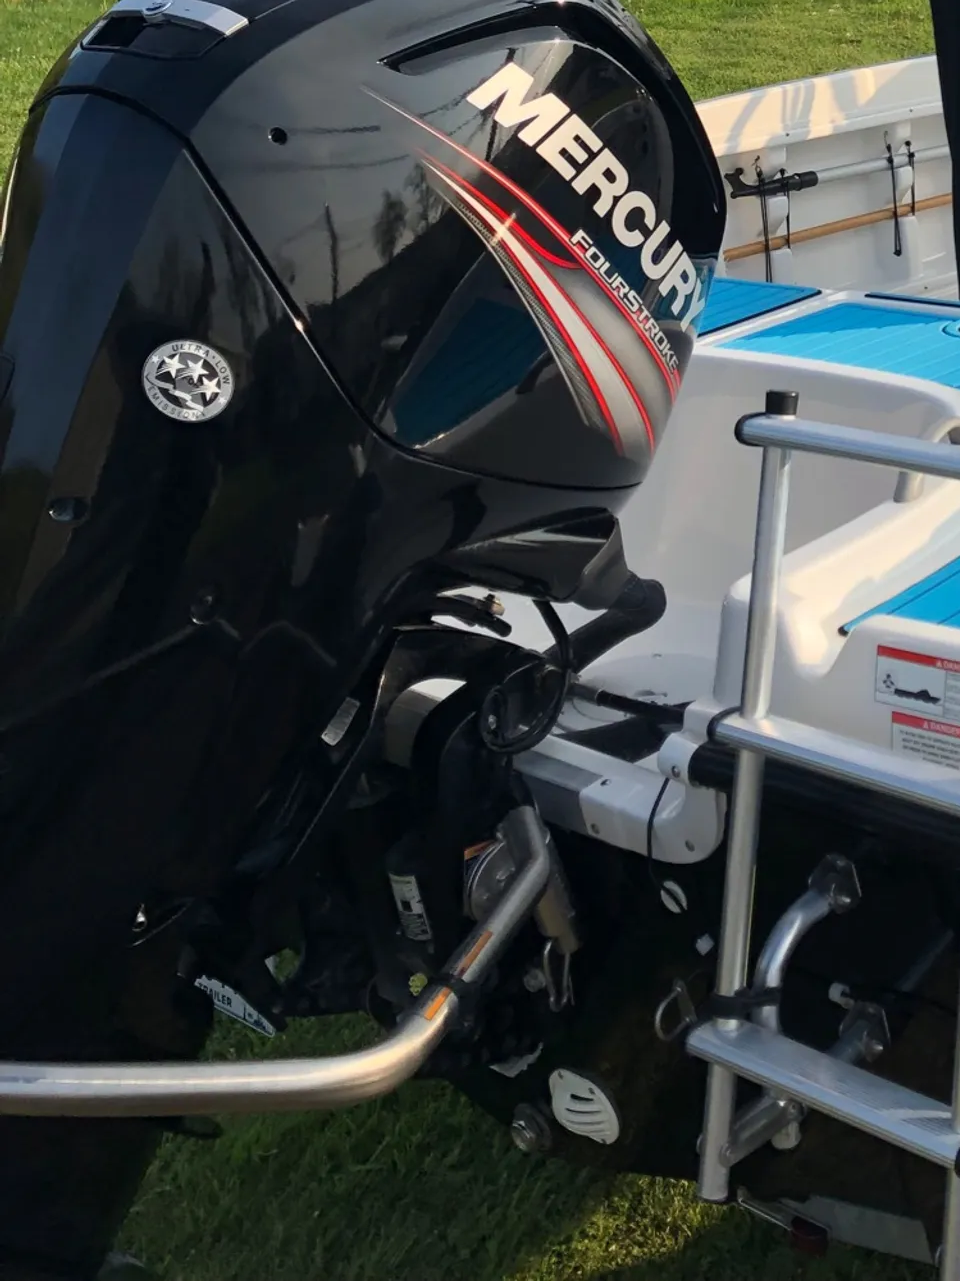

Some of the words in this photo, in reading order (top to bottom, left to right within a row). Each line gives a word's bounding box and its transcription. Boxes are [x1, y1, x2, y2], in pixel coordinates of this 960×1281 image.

[465, 61, 706, 332] MERCURY
[171, 342, 211, 357] ULTRA
[214, 359, 231, 385] LOW
[568, 228, 679, 375] FOURSTROKE
